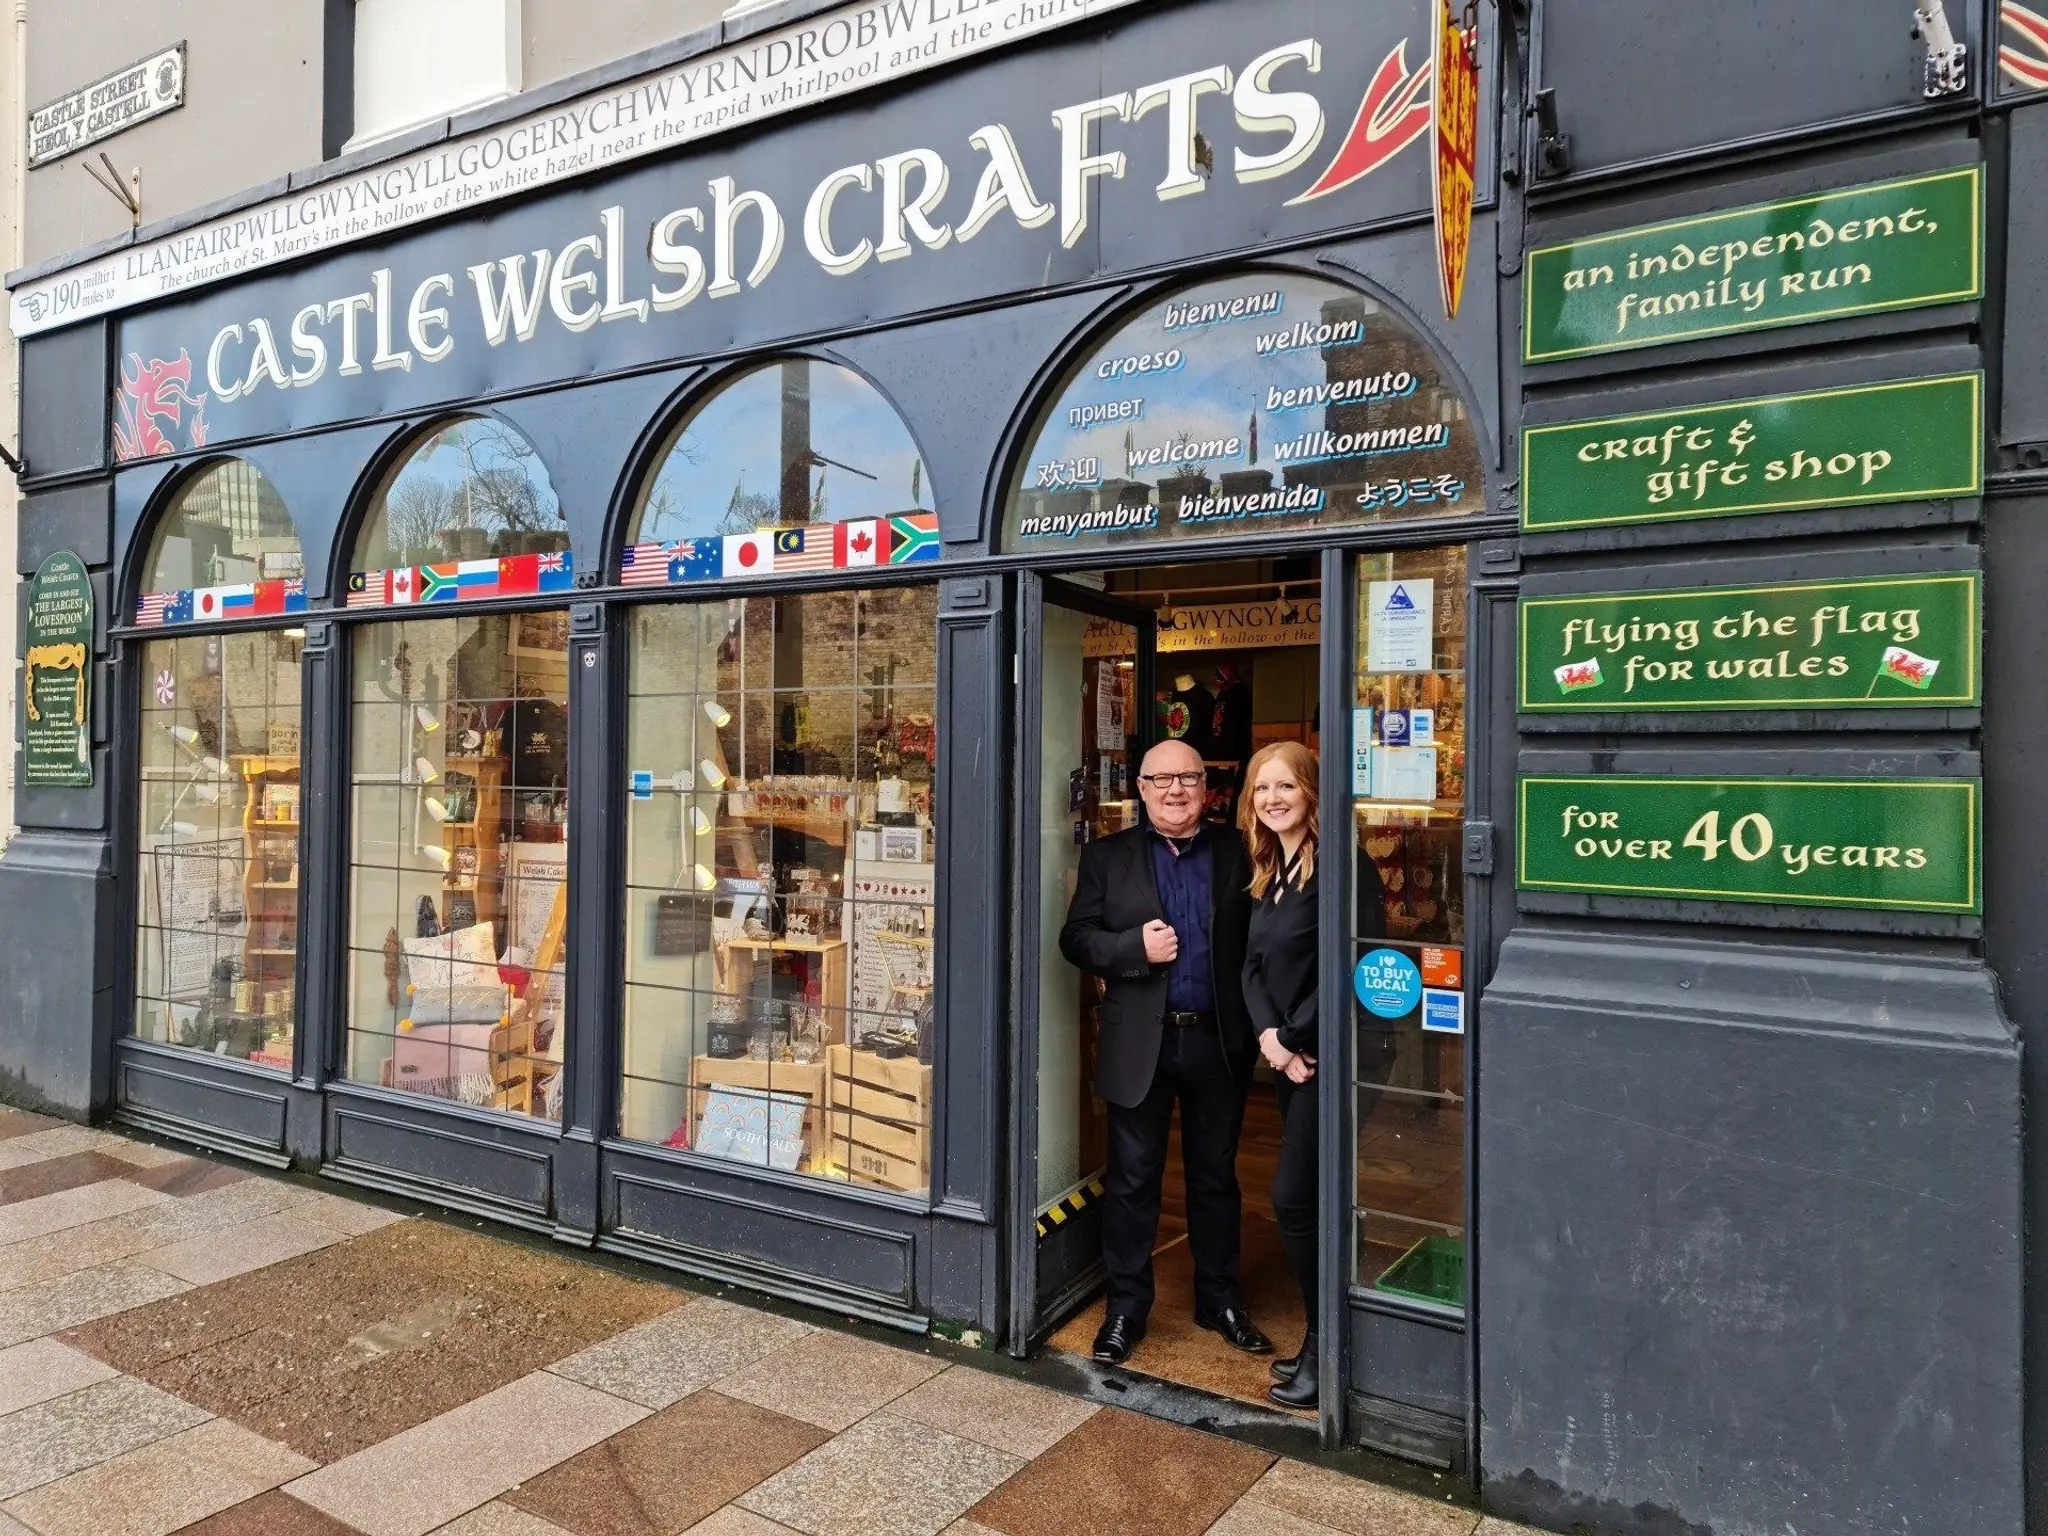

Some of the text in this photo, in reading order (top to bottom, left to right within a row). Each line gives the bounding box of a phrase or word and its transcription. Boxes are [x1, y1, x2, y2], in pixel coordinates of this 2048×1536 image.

[33, 67, 147, 134] CASTLE STREET
[34, 127, 71, 154] HEOL
[73, 119, 84, 140] Y
[87, 91, 150, 133] CASTELL
[126, 0, 1000, 281] LLANFAIRPWLLGWYNGYLLGOGERYCHWYRNDROBWL
[160, 0, 1092, 291] The church of St. Mary's in the hollow of the white hazel near the rapid whirlpool and the chur
[207, 38, 1326, 402] CASTLE WELSH CRAFTS
[1563, 206, 1938, 292] an independent,
[52, 279, 81, 315] 190
[82, 287, 115, 309] miles to
[1163, 291, 1279, 330] bienvenu
[1616, 277, 1766, 333] family
[1256, 318, 1360, 355] welkom
[1098, 348, 1183, 380] croeso
[1265, 370, 1412, 412] benvenuto
[1069, 397, 1144, 428] привет
[1129, 436, 1241, 469] welcome
[1274, 422, 1444, 461] willkommen
[1727, 420, 1756, 456] &
[1036, 455, 1099, 488] 欢迎
[1356, 473, 1460, 505] ようこそ
[1646, 448, 1892, 503] gift shop
[1019, 502, 1155, 537] menyambut
[1178, 483, 1321, 520] bienvenida
[35, 598, 83, 613] THE LARGEST
[35, 611, 83, 627] LOVESPOON
[1174, 634, 1186, 647] in
[1194, 634, 1213, 646] the
[1220, 631, 1268, 645] hollow
[1274, 629, 1288, 646] of
[1295, 629, 1315, 641] the
[1562, 605, 1920, 655] flying the flag
[1706, 652, 1849, 679] wales
[1683, 810, 1773, 862] 40
[1362, 965, 1413, 981] TO BUY
[1365, 978, 1410, 992] LOCAL
[724, 1127, 797, 1153] SOUTH WALES
